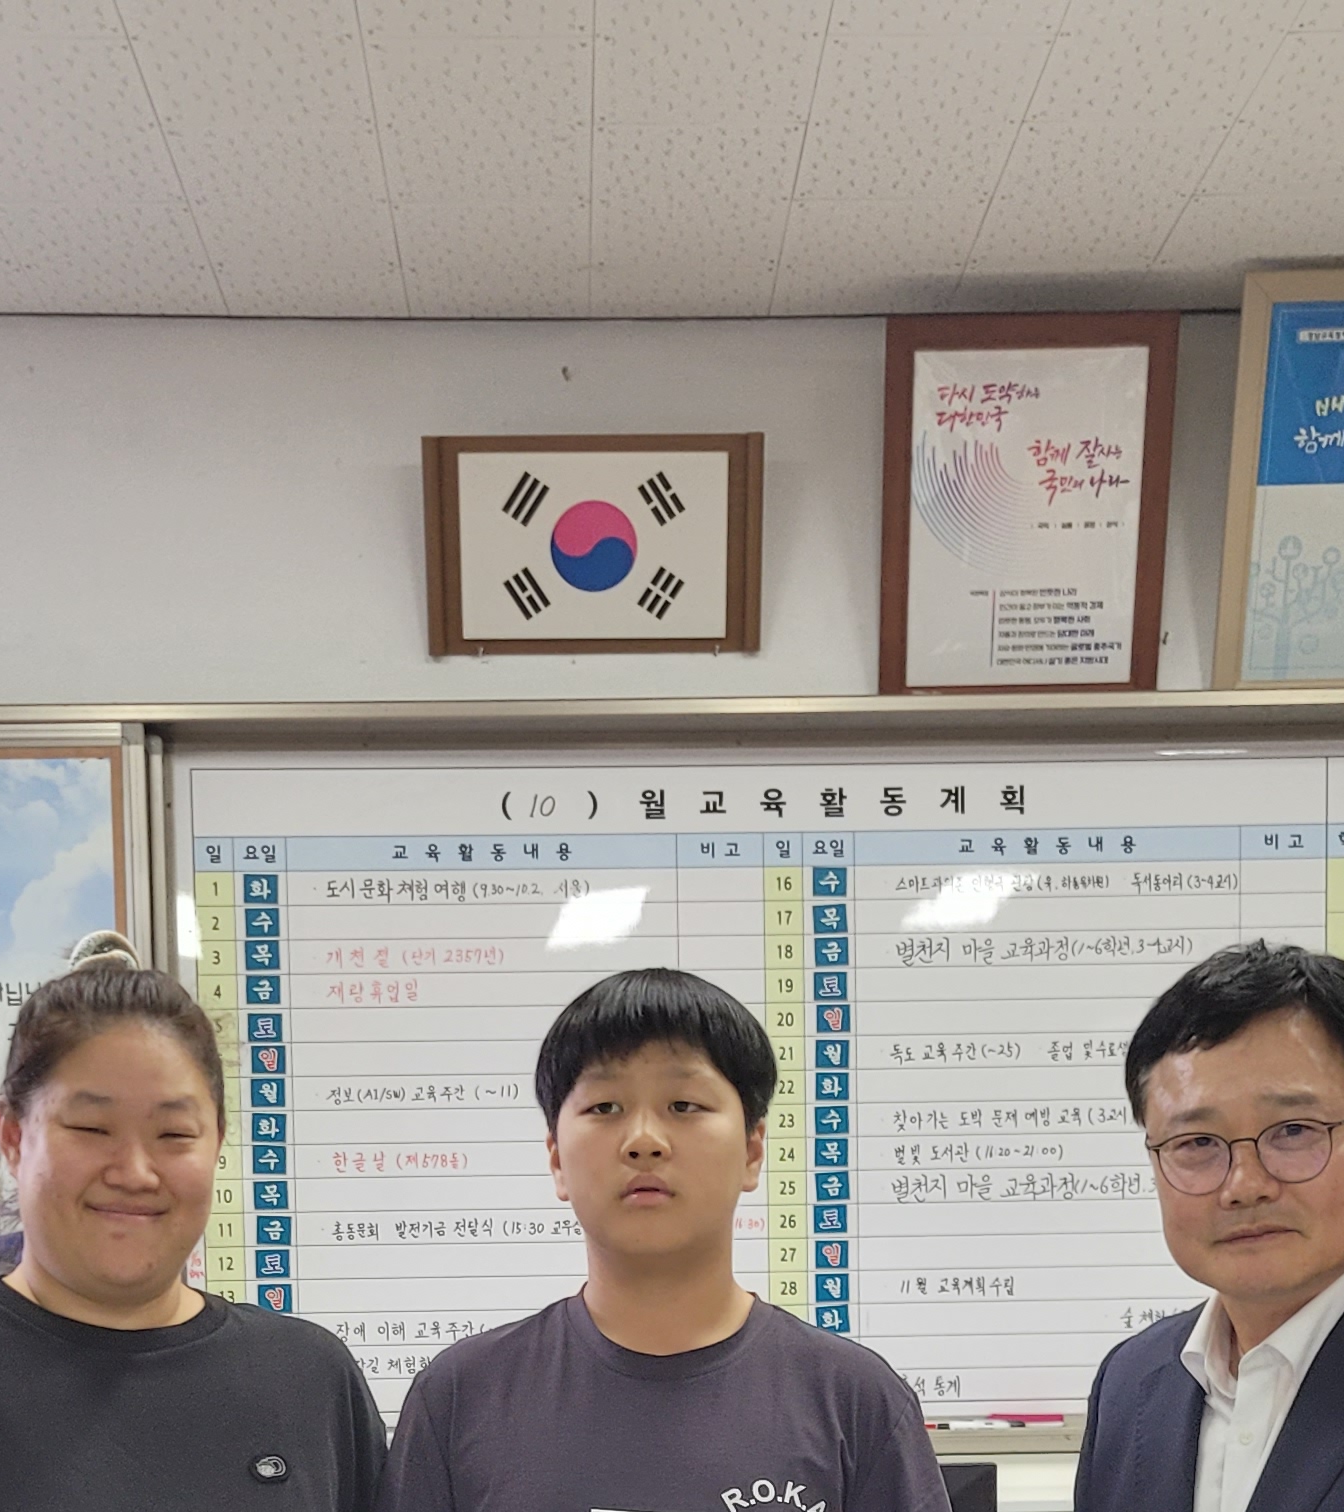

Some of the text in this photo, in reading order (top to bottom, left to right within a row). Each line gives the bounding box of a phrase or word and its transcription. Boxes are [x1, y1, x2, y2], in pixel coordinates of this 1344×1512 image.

[937, 383, 975, 406] 다시
[936, 406, 1008, 432] 대한민국
[1027, 437, 1071, 467] 함께
[205, 843, 222, 863] 일
[242, 841, 277, 862] 요일
[775, 838, 793, 859] 일
[811, 837, 845, 859] 요일
[326, 878, 356, 900] 도시
[359, 878, 393, 903] 문화
[433, 879, 467, 903] 여행
[776, 876, 792, 891] 16
[961, 936, 996, 966] 마을
[889, 1042, 916, 1066] 독도
[778, 1113, 795, 1129] 23
[958, 1106, 983, 1128] 도박
[991, 1109, 1018, 1128] 문제
[1024, 1106, 1051, 1128] 예방
[1057, 1106, 1083, 1127] 교육
[778, 1147, 795, 1162] 24
[930, 1142, 969, 1164] 도서관
[216, 1189, 233, 1204] 10
[779, 1181, 796, 1196] 25
[956, 1172, 994, 1201] 마을
[218, 1223, 233, 1238] 11
[331, 1217, 494, 1242] 총동문회 발전기금 전달식
[779, 1214, 797, 1229] 26
[218, 1256, 234, 1271] 12
[779, 1247, 797, 1263] 27
[780, 1281, 797, 1296] 28
